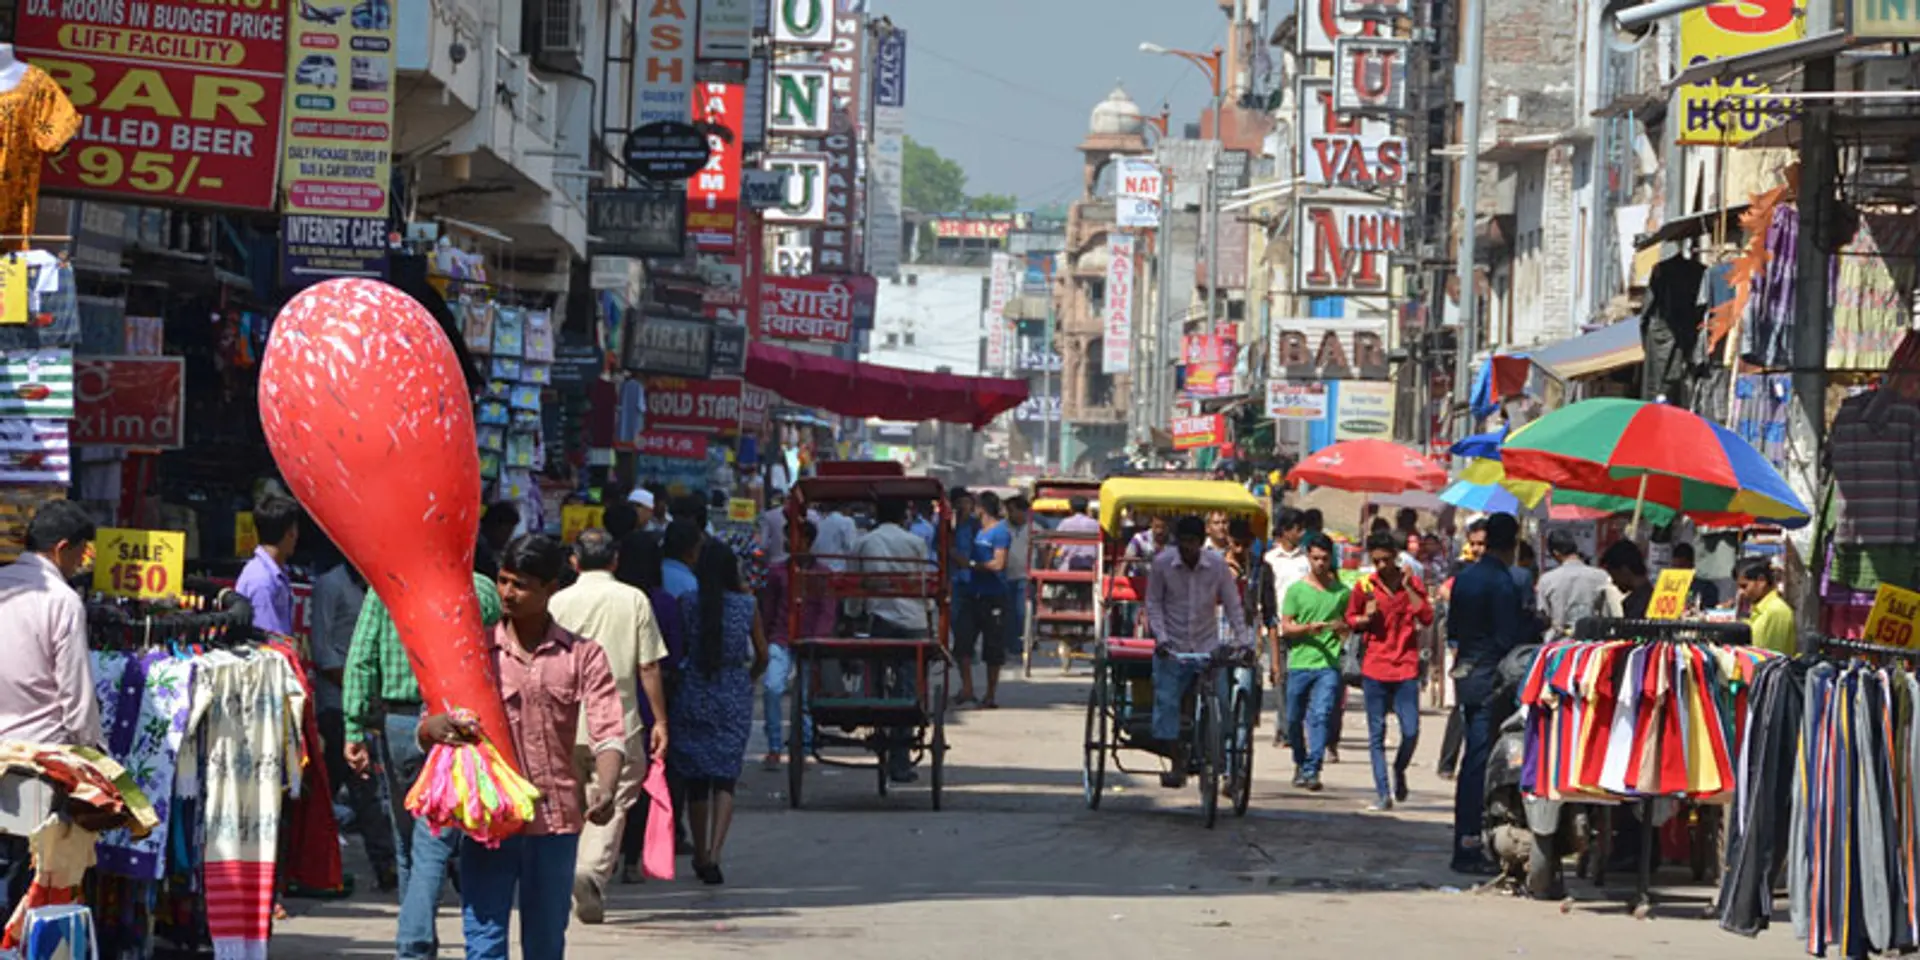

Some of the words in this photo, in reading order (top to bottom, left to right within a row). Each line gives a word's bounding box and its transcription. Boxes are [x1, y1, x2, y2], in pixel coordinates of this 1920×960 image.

[61, 1, 124, 26] ROOMS
[130, 8, 148, 27] IN
[154, 11, 226, 35] BUDGET
[231, 17, 283, 40] PRICE
[71, 27, 122, 48] LIFT
[128, 34, 233, 62] FACILITY
[28, 58, 265, 126] BAR
[171, 126, 254, 158] BEER
[1311, 137, 1403, 186] VAS
[599, 200, 678, 230] KAILASH
[287, 215, 349, 246] INTERNET
[350, 218, 386, 248] CAFE
[1347, 215, 1400, 250] INN
[1110, 244, 1130, 337] NATURAL
[635, 322, 706, 353] KIRAN
[1279, 329, 1389, 378] BAR
[648, 391, 692, 416] GOLD
[697, 393, 739, 420] STAR
[118, 542, 163, 562] SALE
[110, 562, 168, 594] 150
[1888, 597, 1917, 621] SALE
[1877, 616, 1914, 648] 150
